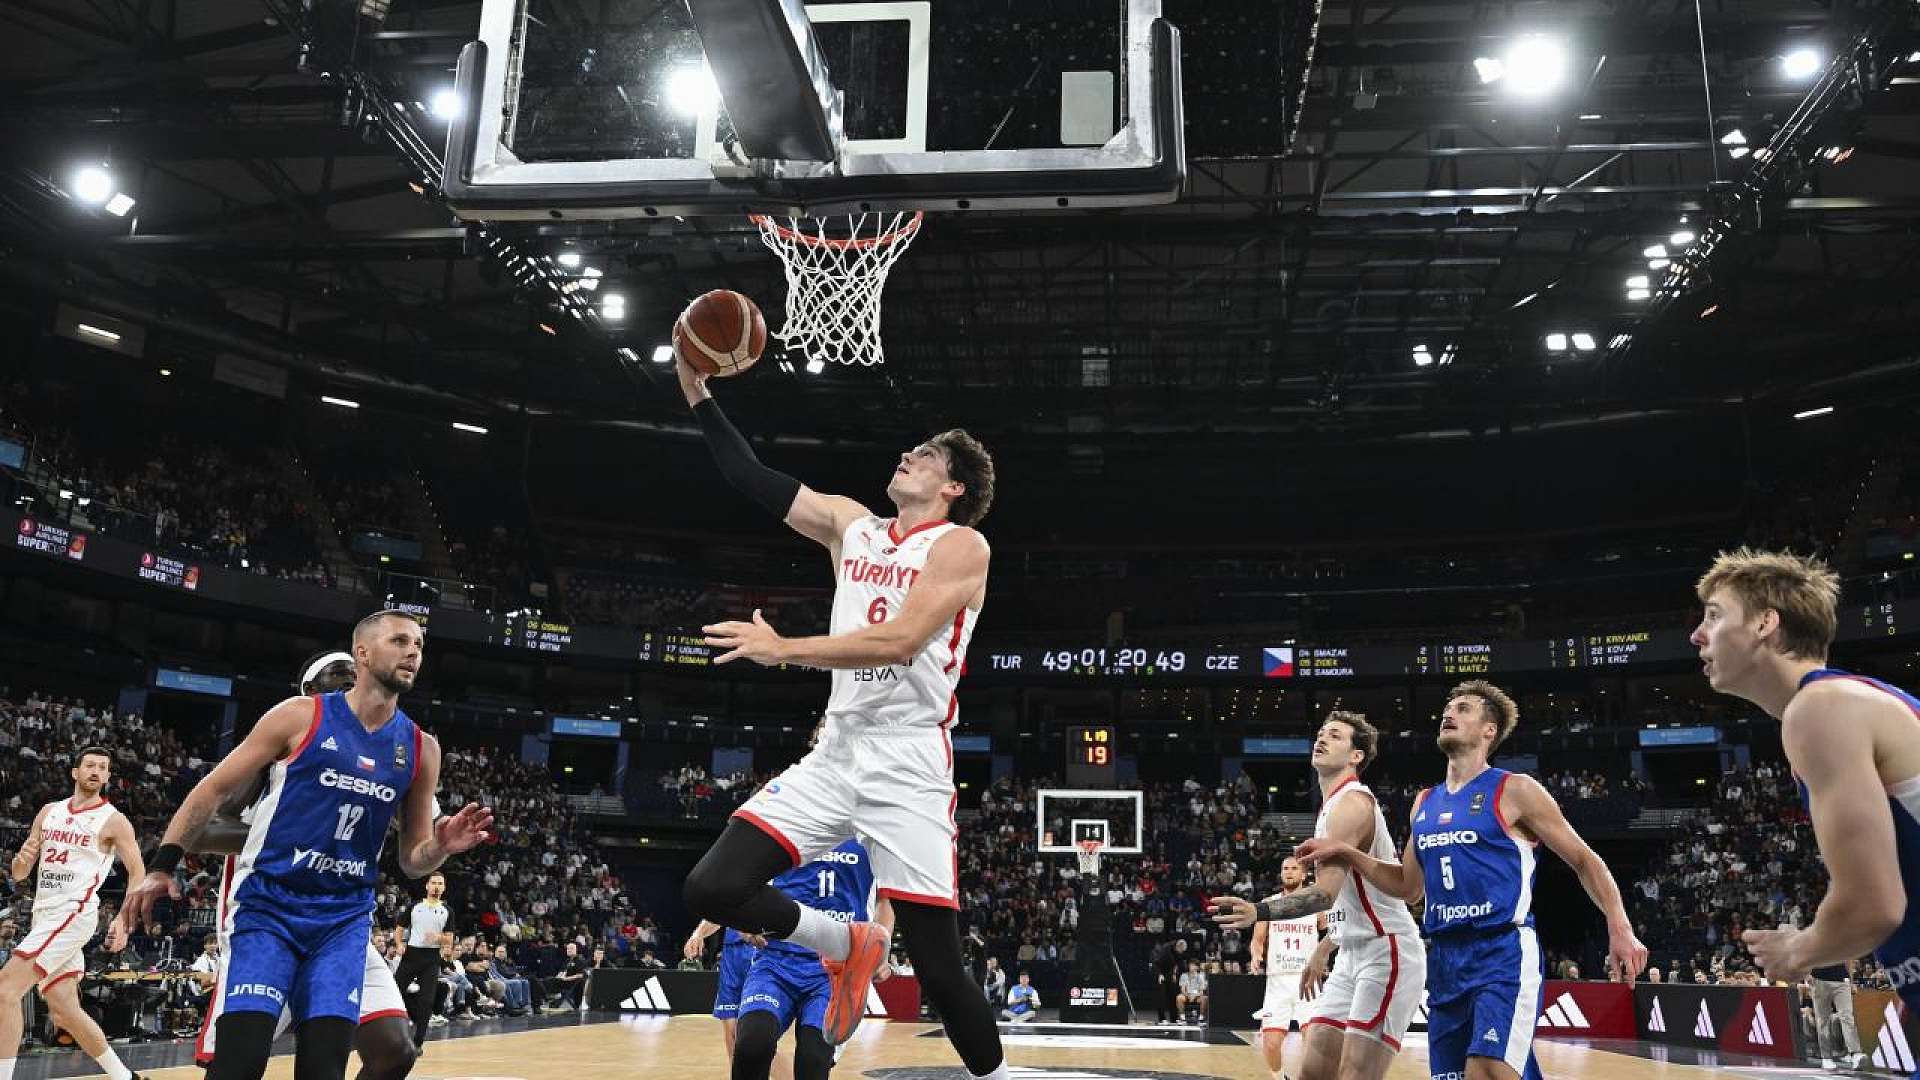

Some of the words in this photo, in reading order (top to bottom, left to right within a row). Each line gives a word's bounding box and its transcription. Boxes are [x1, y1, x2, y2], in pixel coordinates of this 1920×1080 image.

[867, 596, 888, 625] 6
[991, 654, 1022, 670] TUR
[1042, 651, 1072, 671] 49
[1156, 651, 1186, 671] 49
[1205, 656, 1240, 670] CZE
[1088, 746, 1108, 765] 19
[319, 767, 397, 802] ČESKO
[334, 803, 365, 841] 12
[1418, 830, 1479, 850] ČESKO
[45, 848, 69, 864] 24
[306, 850, 367, 877] Tipsport
[817, 869, 835, 898] 11
[1439, 856, 1455, 890] 5
[1436, 901, 1493, 923] Tipsport
[1284, 937, 1300, 951] 11
